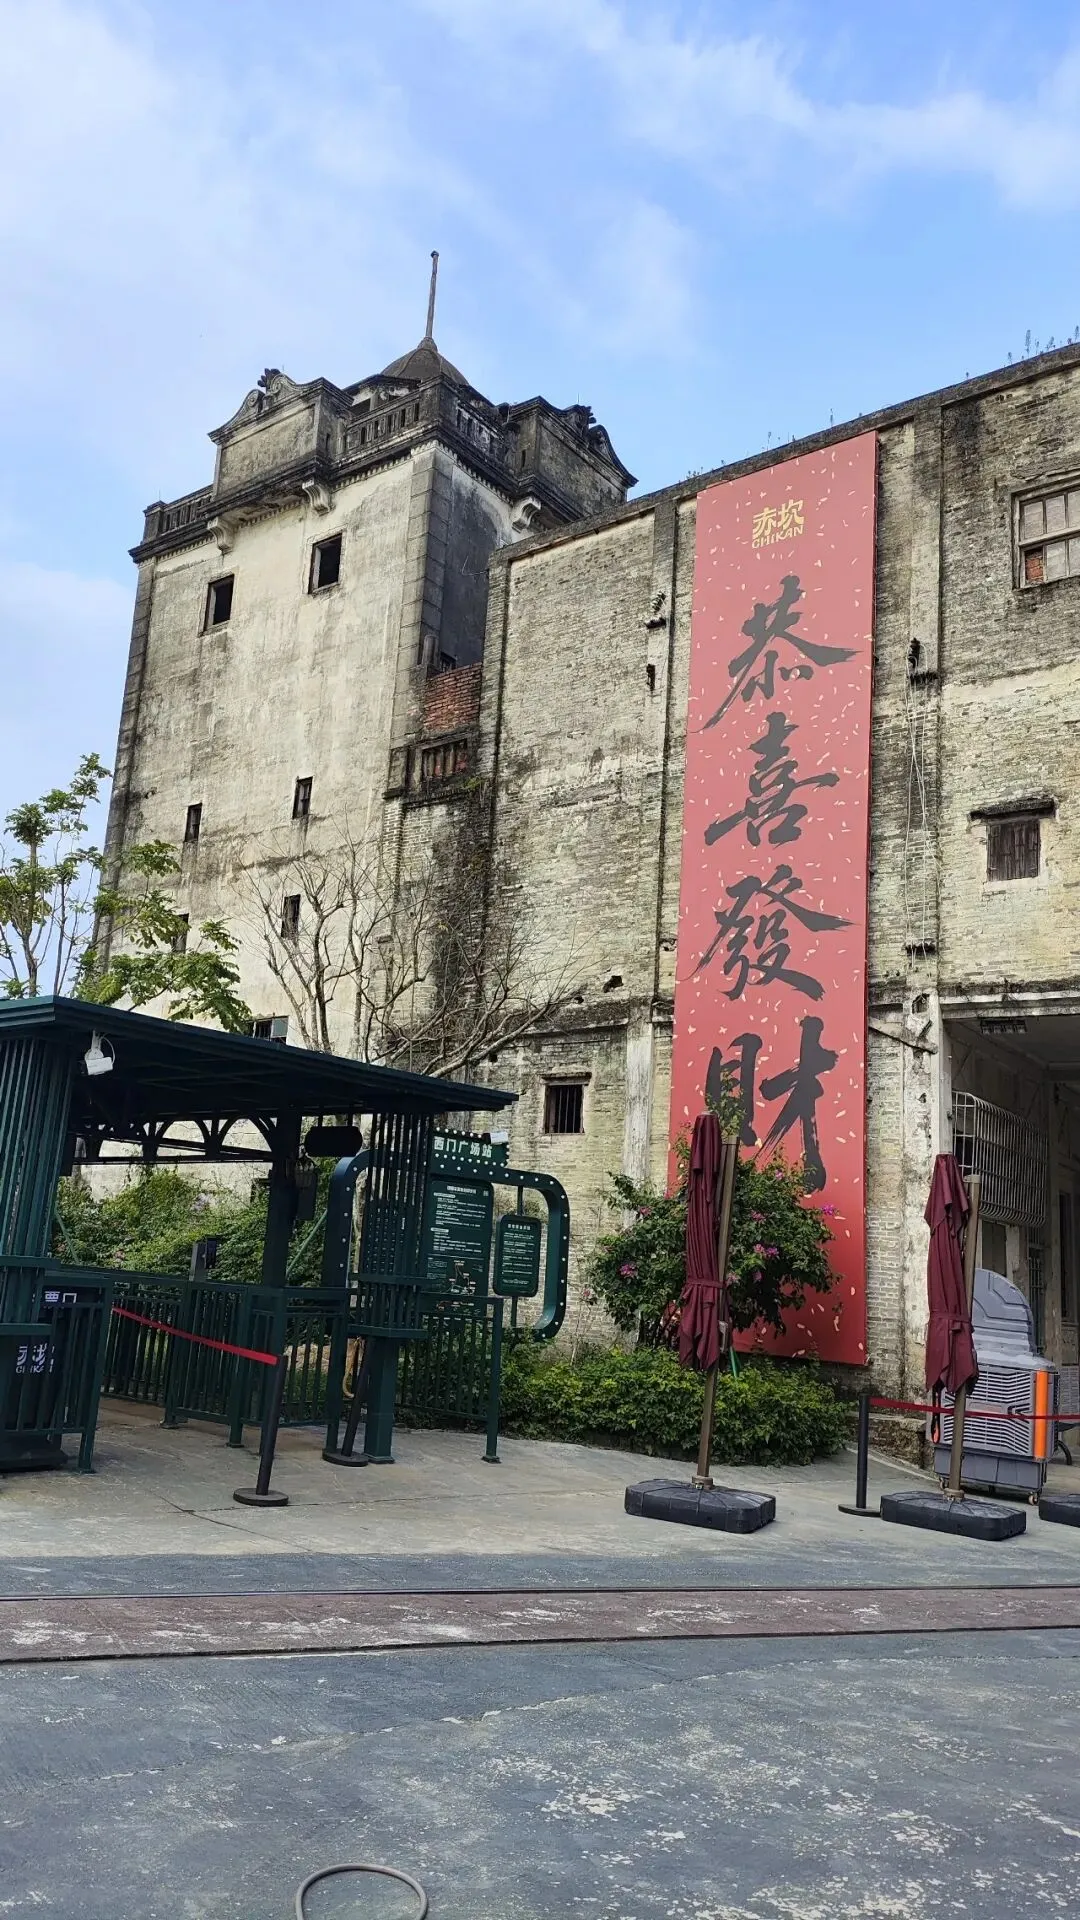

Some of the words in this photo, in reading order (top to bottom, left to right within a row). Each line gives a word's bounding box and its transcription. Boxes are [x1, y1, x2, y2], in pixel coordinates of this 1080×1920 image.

[752, 499, 804, 540] 赤坎
[751, 524, 803, 549] CHIKAN
[679, 574, 863, 1195] 恭喜發財
[433, 1135, 493, 1158] 西门广场站
